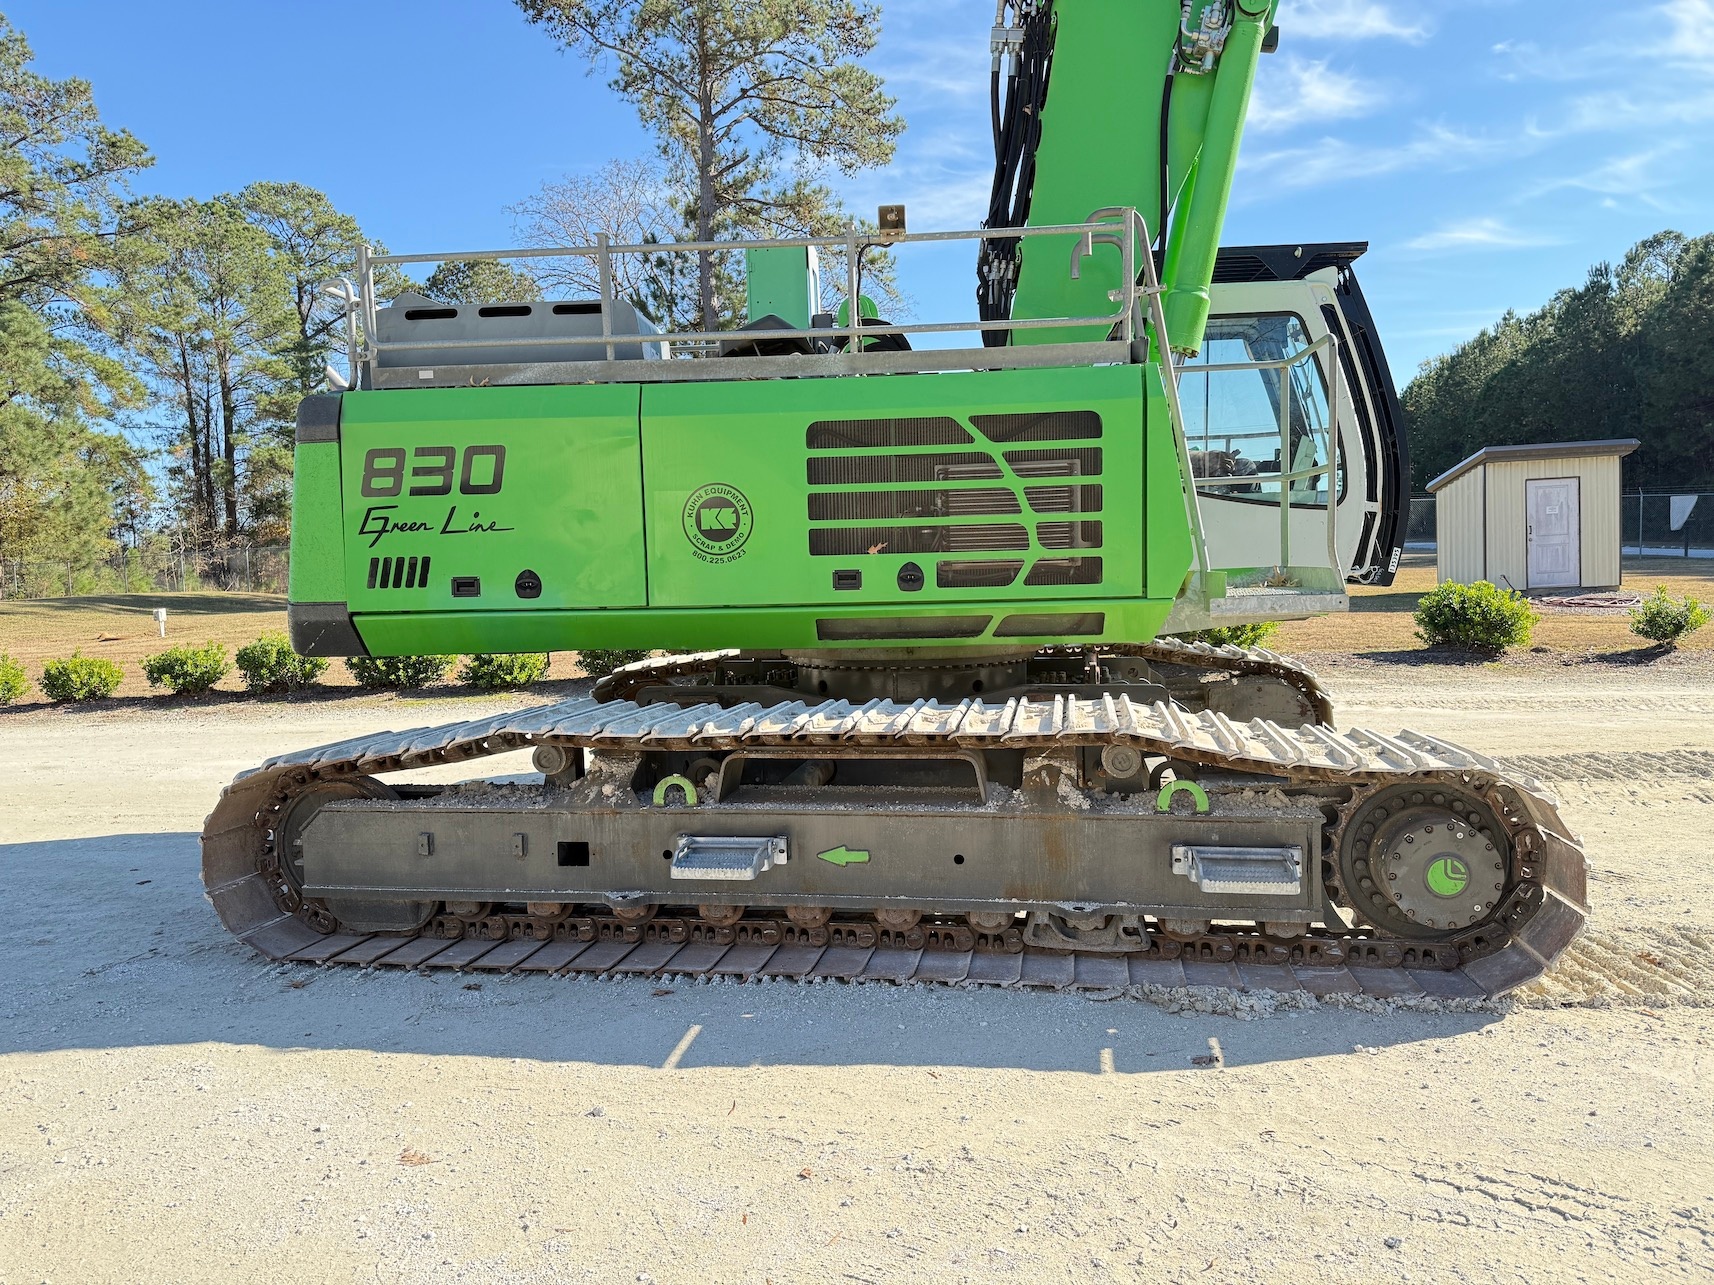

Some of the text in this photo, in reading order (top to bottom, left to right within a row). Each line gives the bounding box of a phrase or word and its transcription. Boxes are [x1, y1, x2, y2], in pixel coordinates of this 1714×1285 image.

[361, 444, 506, 497] 830
[687, 488, 748, 518] KUHN EQUIPMENT
[358, 505, 515, 548] Green Line
[692, 549, 746, 564] 800.225.0623
[693, 534, 715, 551] SCRAP
[726, 533, 744, 550] DEMO
